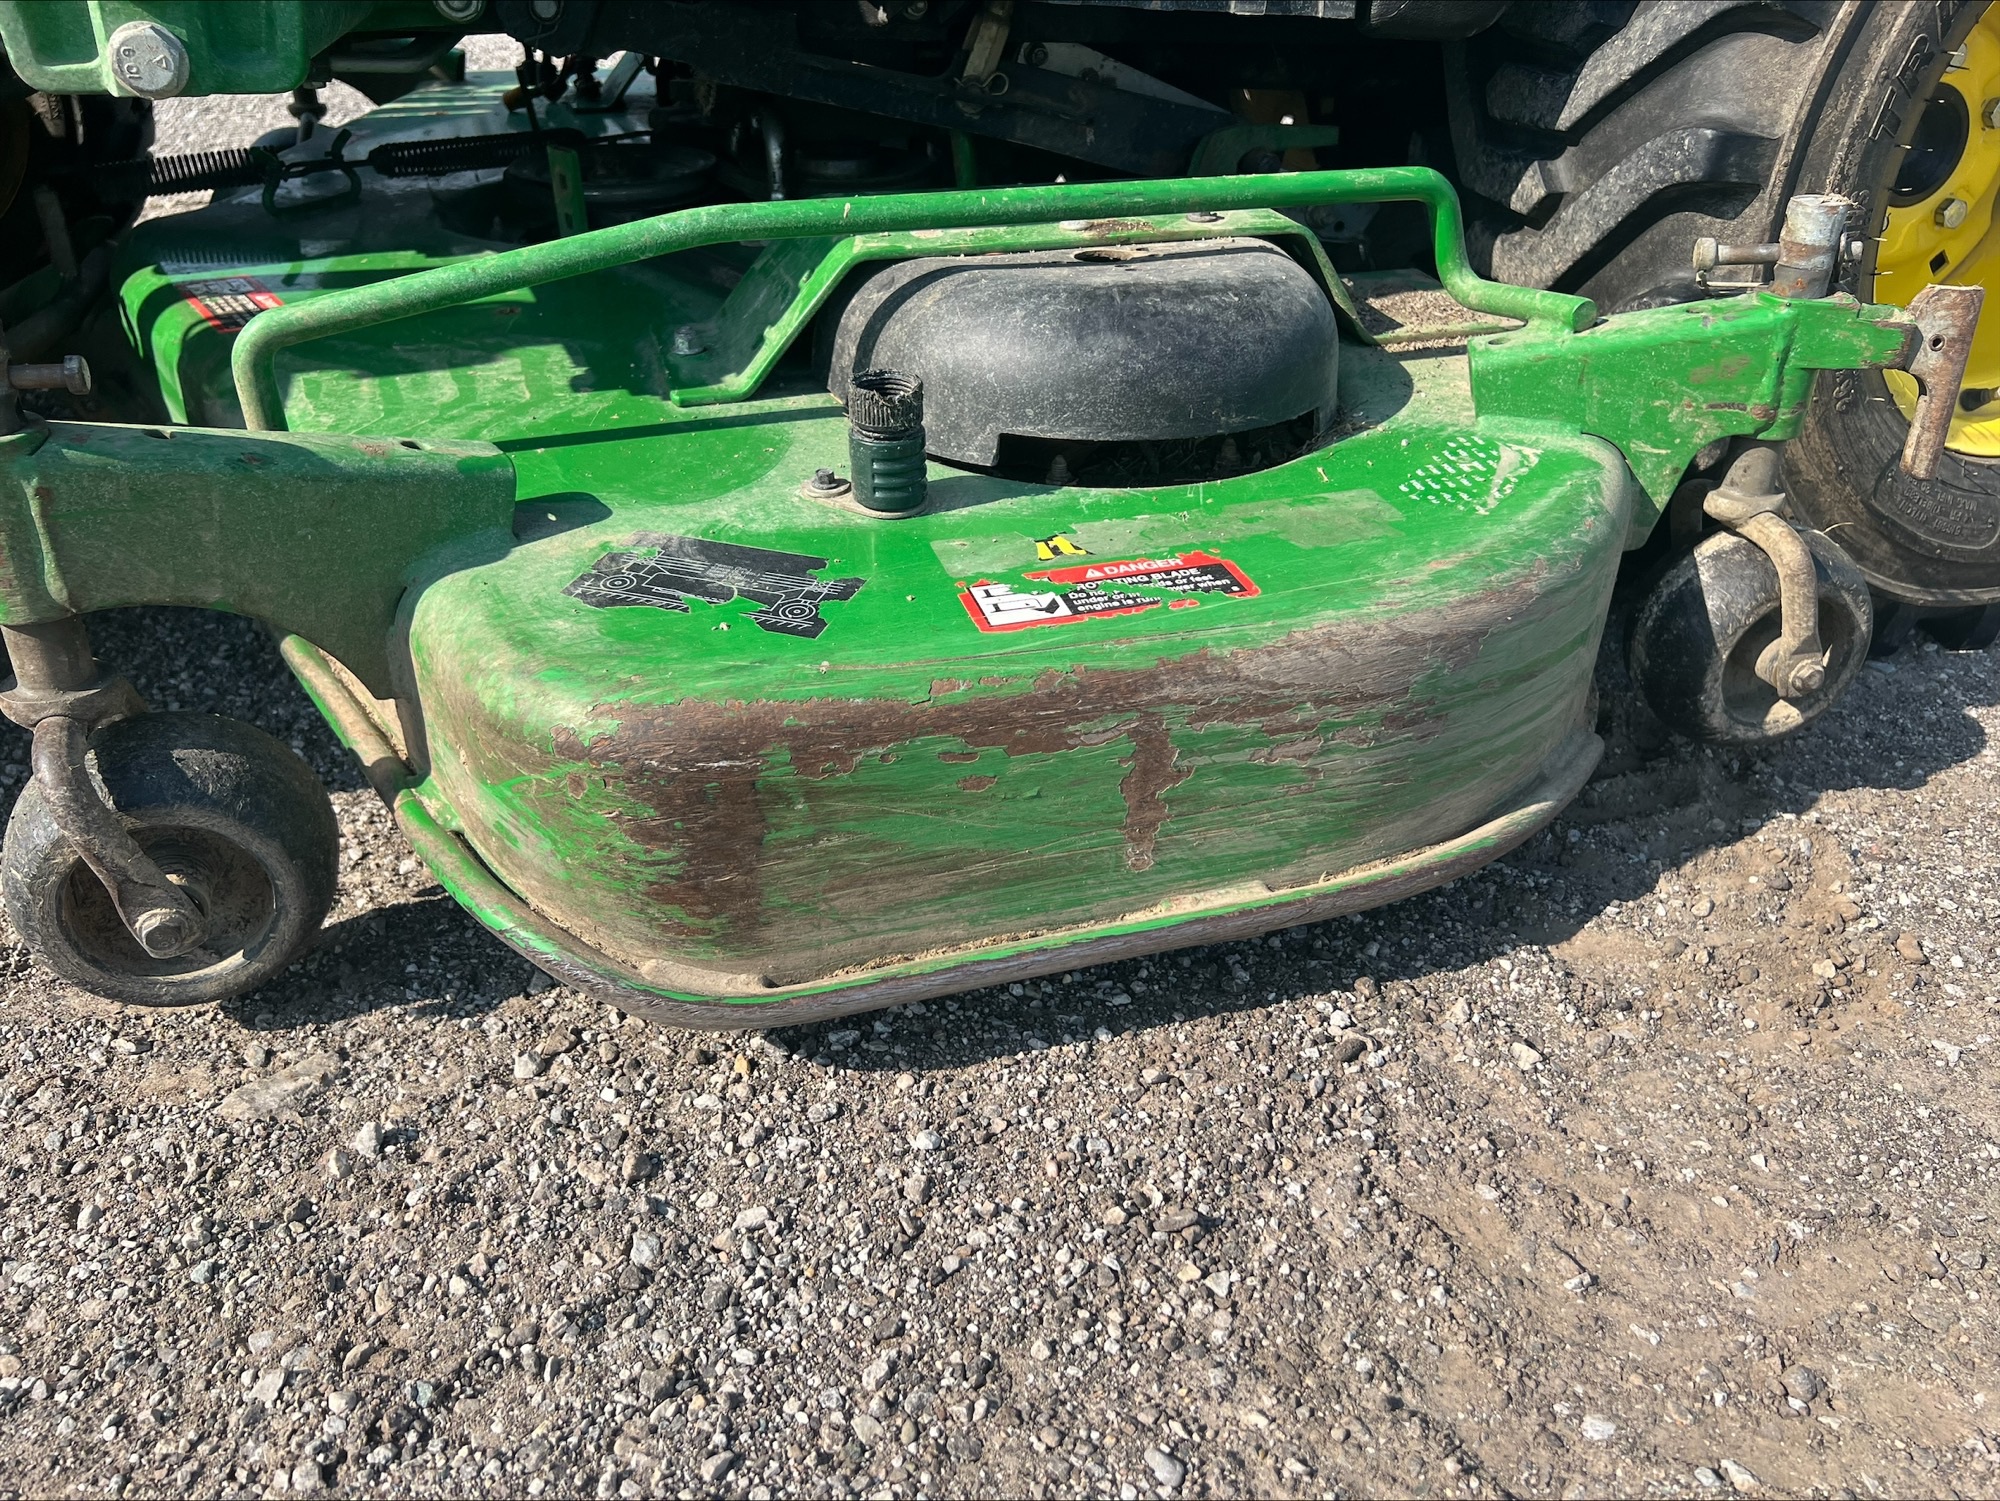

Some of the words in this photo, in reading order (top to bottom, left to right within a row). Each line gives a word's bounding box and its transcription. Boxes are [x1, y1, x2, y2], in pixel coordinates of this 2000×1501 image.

[1104, 558, 1184, 575] DANGER
[1076, 574, 1150, 591] ROTING
[1150, 568, 1201, 580] BLADE
[1073, 596, 1108, 606] under
[1196, 578, 1231, 588] when
[1077, 600, 1121, 612] engine
